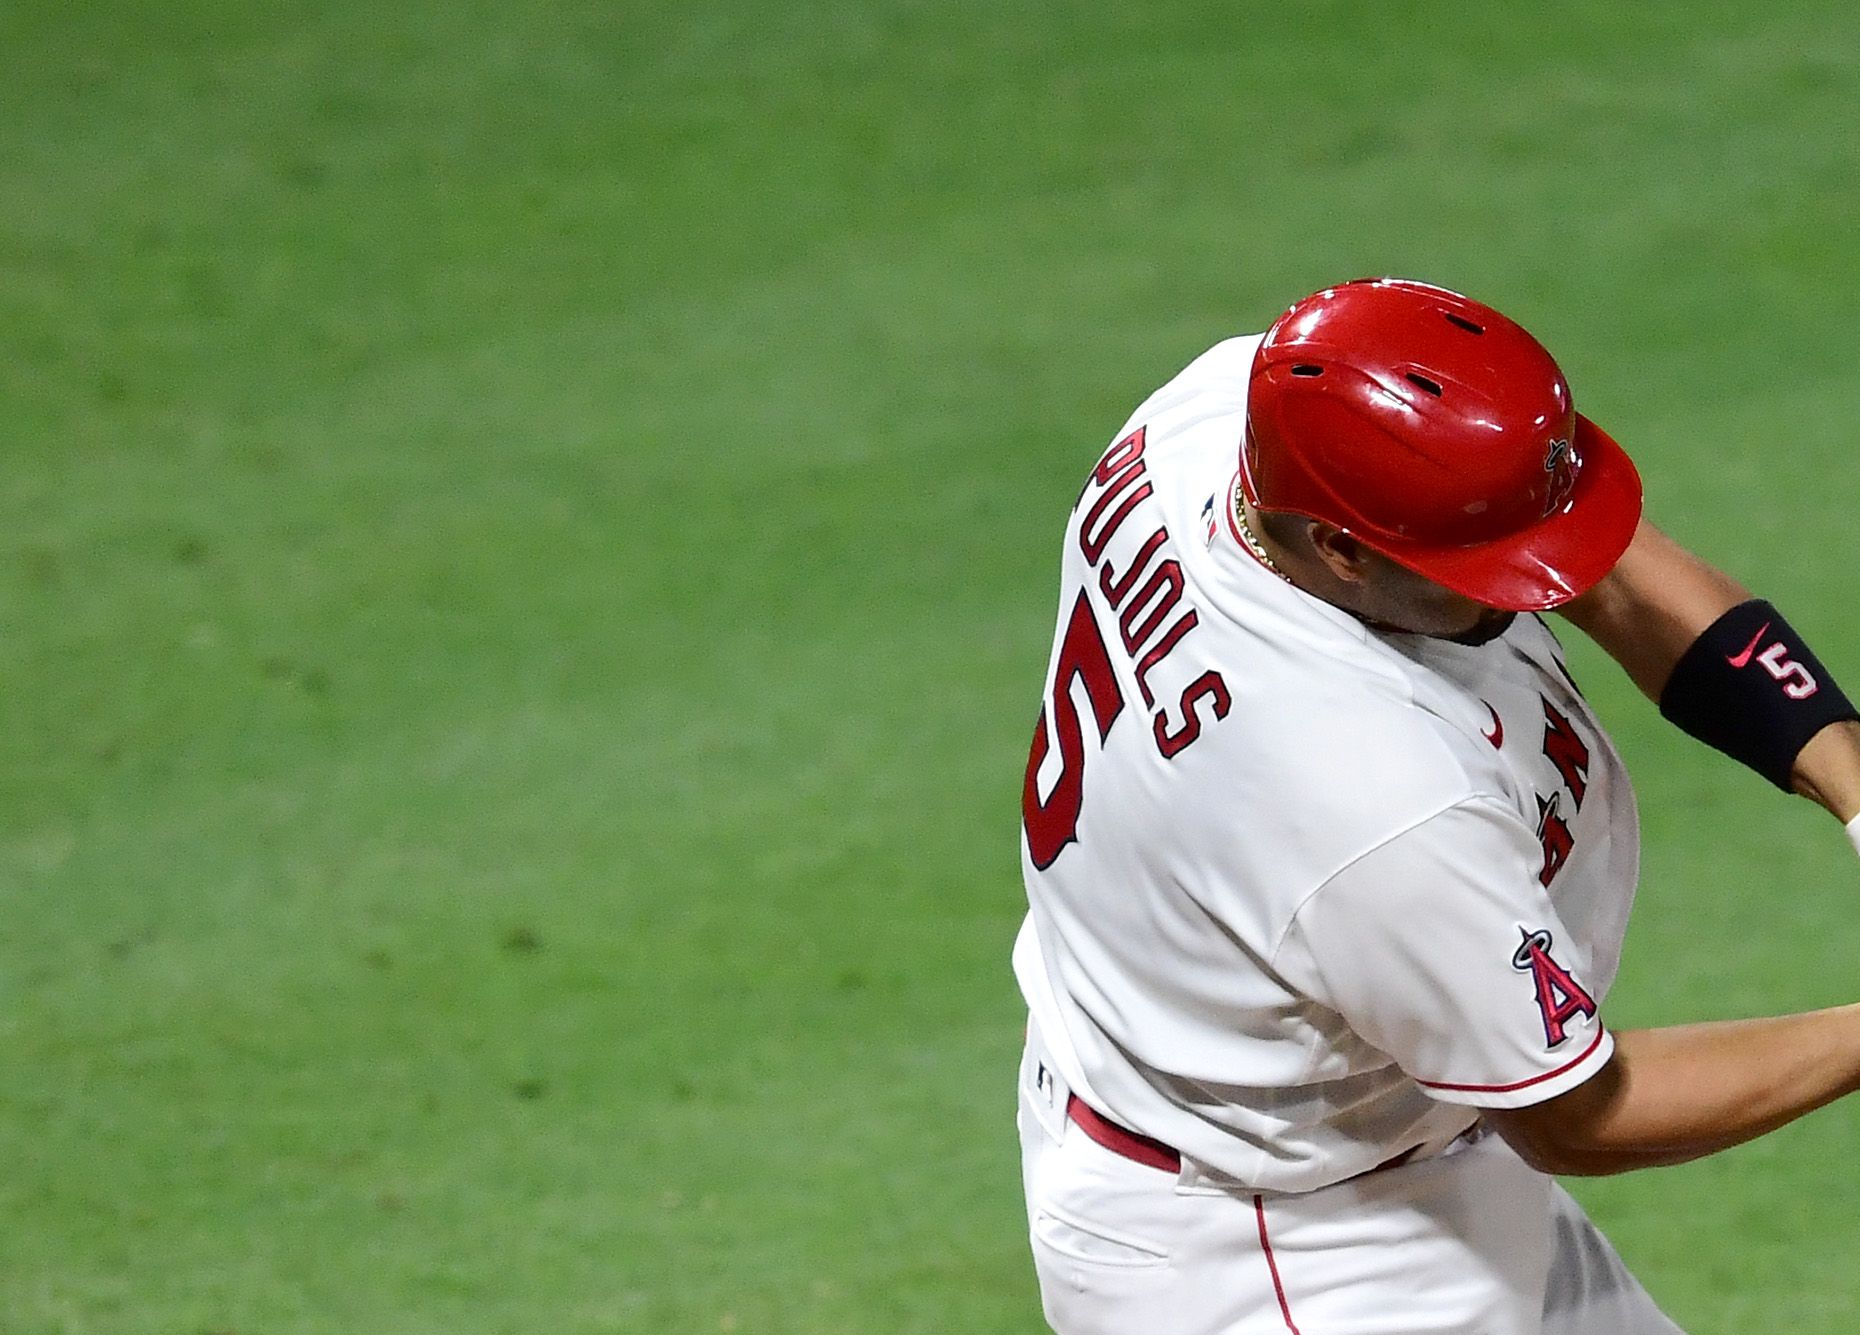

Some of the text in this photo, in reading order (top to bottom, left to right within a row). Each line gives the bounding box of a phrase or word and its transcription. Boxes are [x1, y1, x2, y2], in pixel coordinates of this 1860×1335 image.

[1075, 424, 1232, 760] PUJOLS
[1756, 641, 1820, 700] 5
[1022, 585, 1125, 872] 5
[1512, 925, 1598, 1048] A
